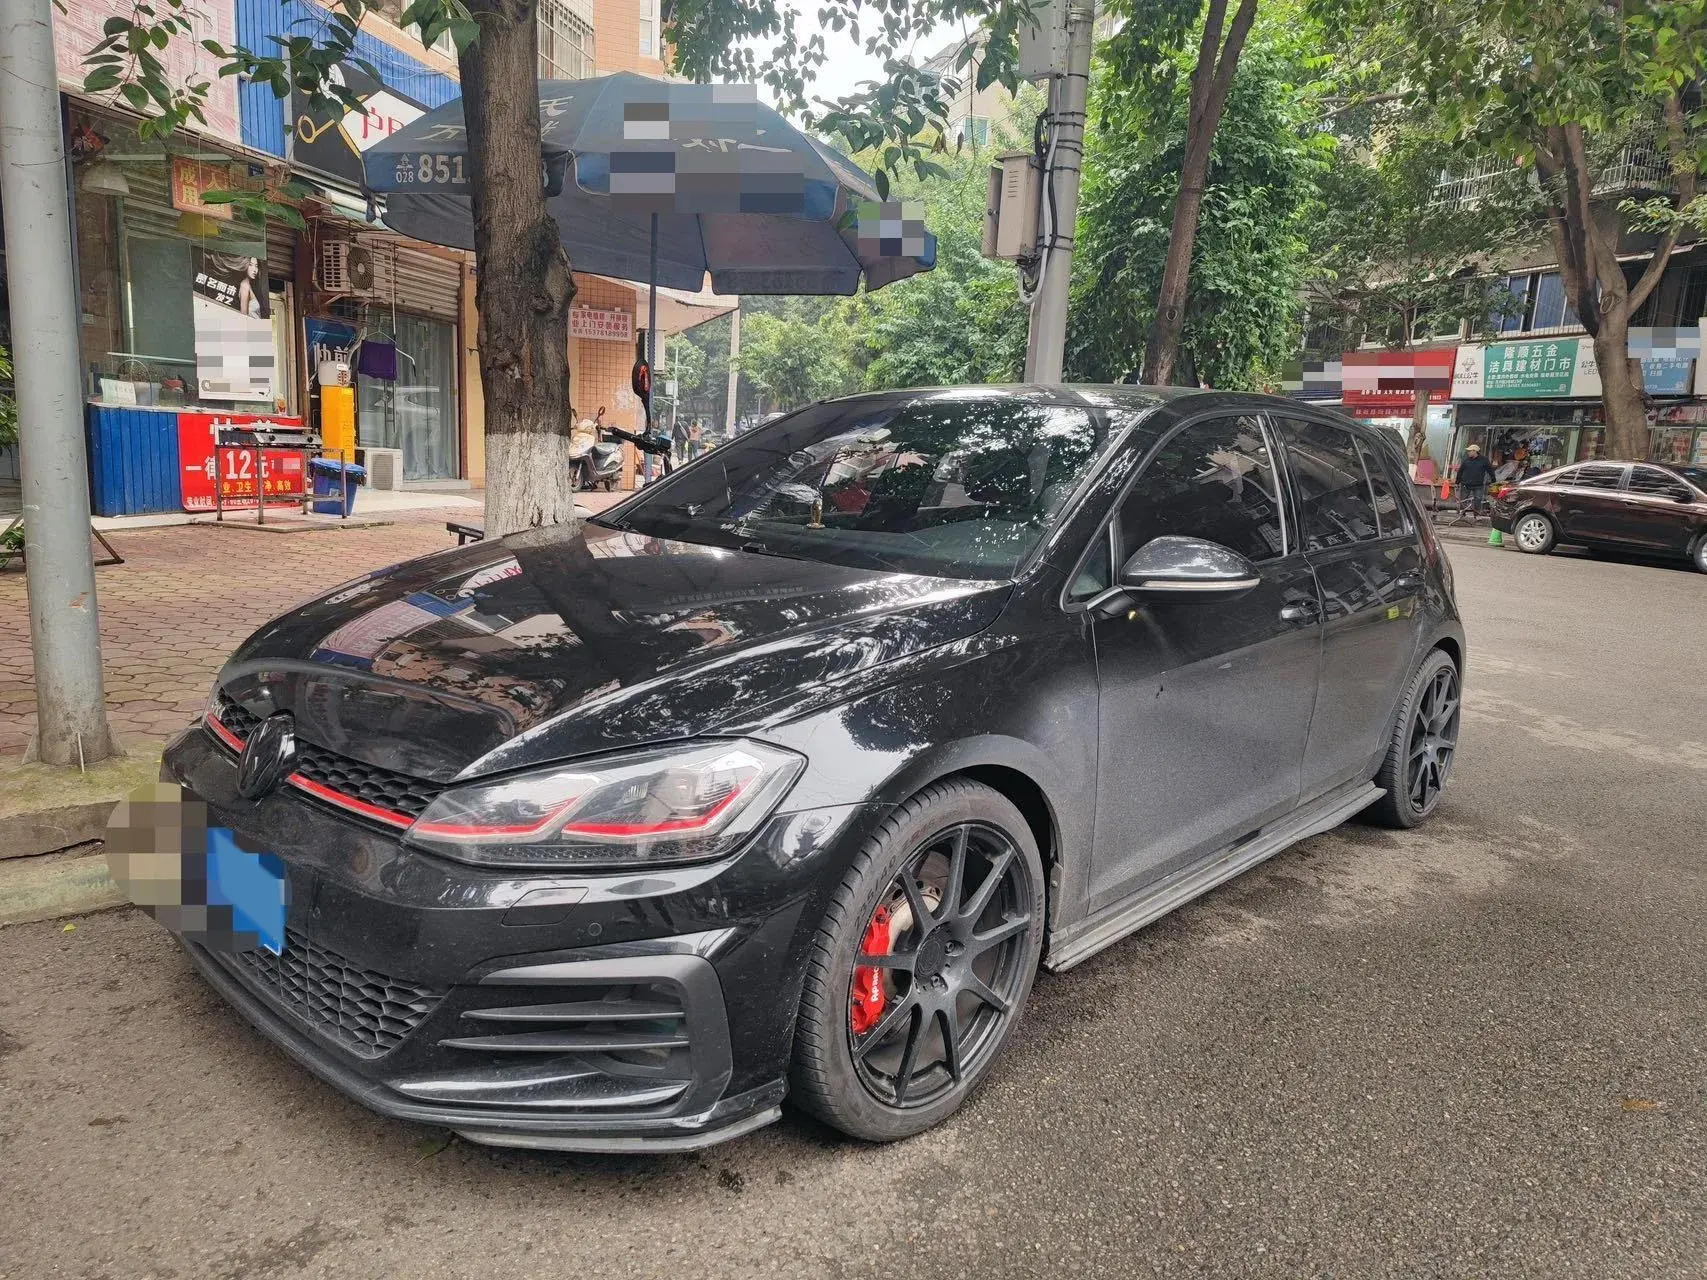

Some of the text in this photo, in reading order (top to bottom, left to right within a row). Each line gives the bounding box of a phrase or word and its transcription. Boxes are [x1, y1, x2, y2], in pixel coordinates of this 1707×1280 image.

[417, 153, 467, 184] 851
[395, 171, 413, 183] 028
[1504, 344, 1559, 359] 隆顺五金
[1489, 357, 1571, 373] 洁具建材门市
